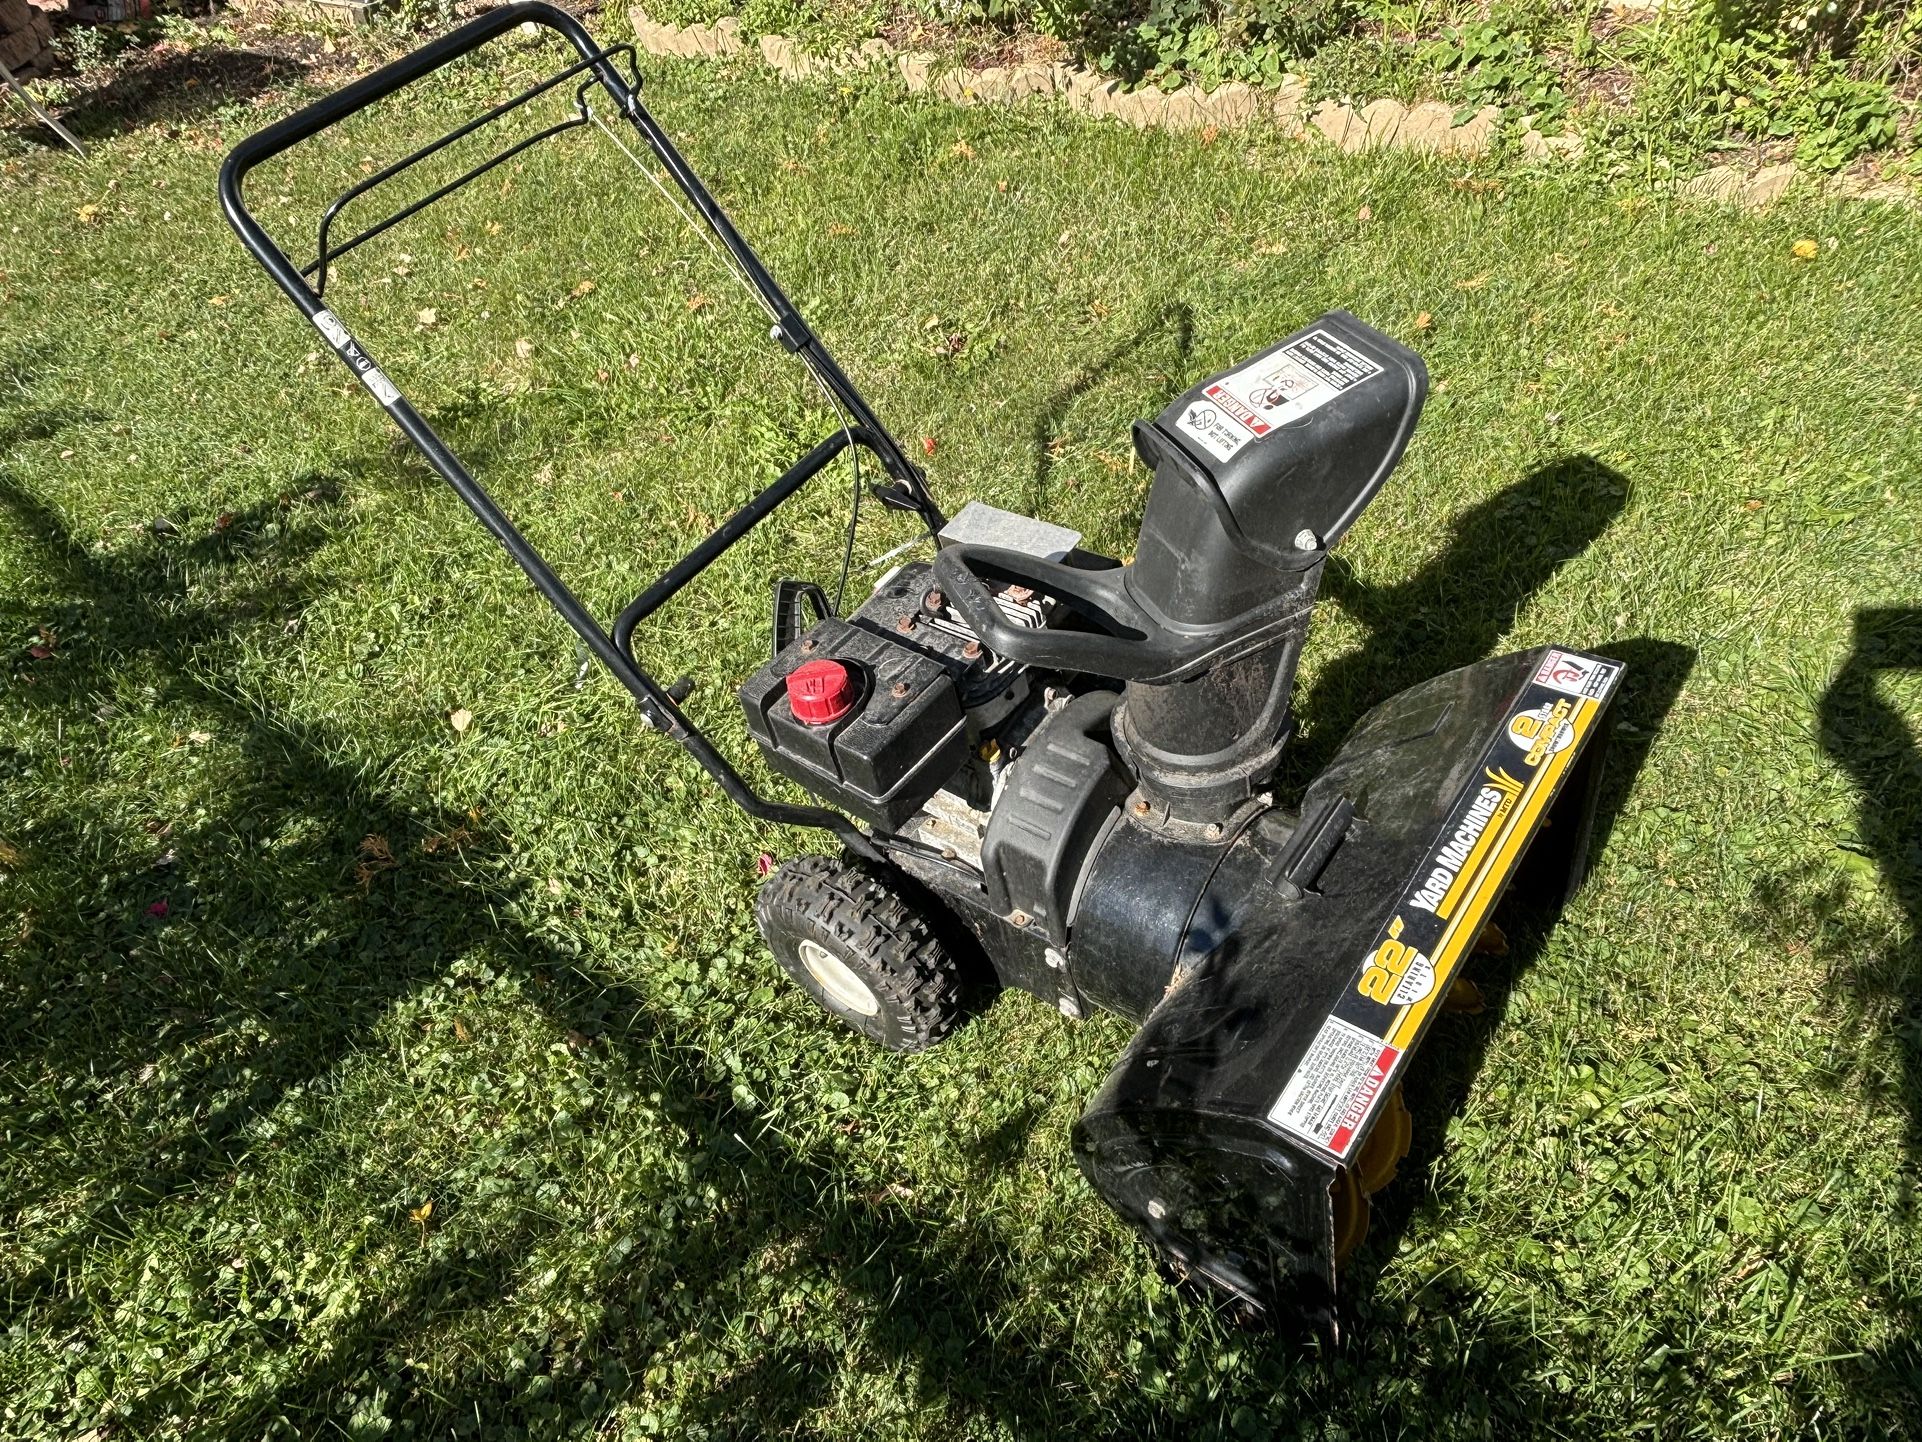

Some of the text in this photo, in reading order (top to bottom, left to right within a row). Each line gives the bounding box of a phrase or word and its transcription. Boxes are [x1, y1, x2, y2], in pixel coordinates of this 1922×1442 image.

[1213, 389, 1254, 426] DANGER
[1511, 716, 1544, 739] 2
[1524, 698, 1571, 766] COMPACT
[1502, 798, 1512, 815] MTD
[1409, 787, 1502, 913] YARD MACHINES
[1397, 961, 1424, 1000] CLEARING
[1341, 1072, 1382, 1131] DANGER
